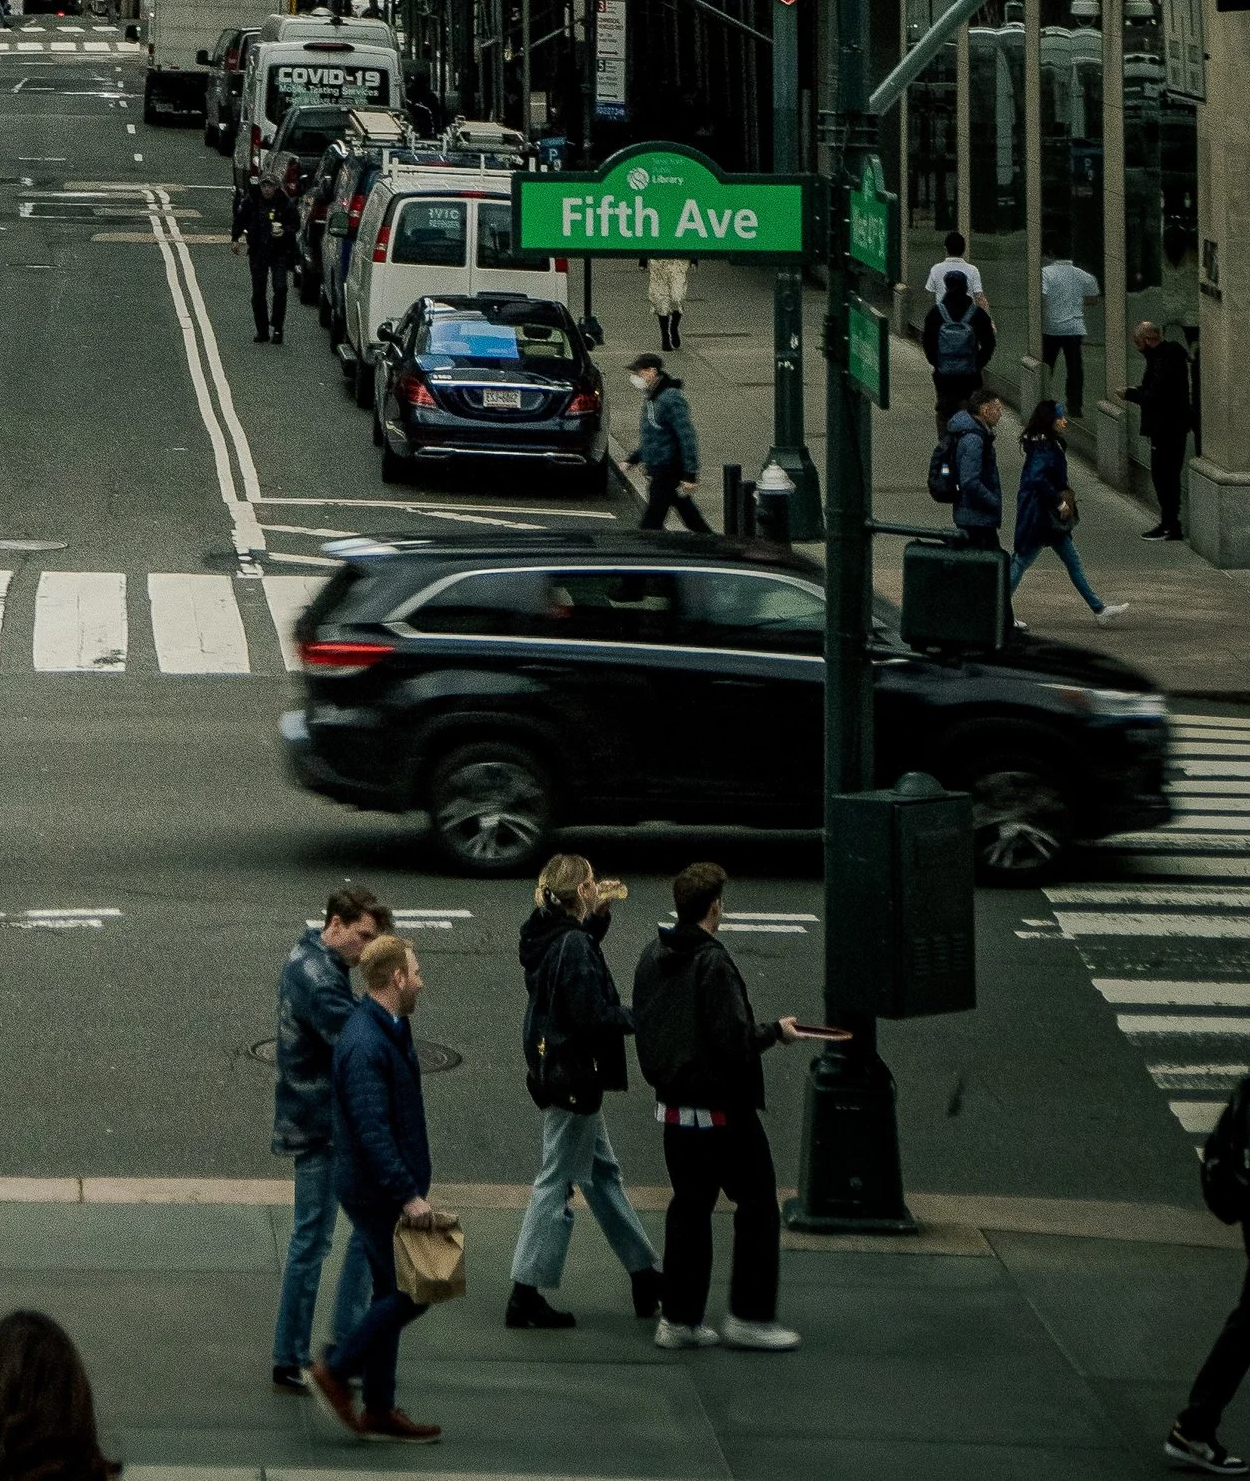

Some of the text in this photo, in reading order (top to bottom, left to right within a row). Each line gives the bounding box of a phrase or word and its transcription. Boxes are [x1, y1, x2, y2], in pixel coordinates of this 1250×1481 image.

[278, 67, 381, 87] COVID-19
[308, 85, 340, 97] Testing
[342, 86, 379, 97] Services
[651, 174, 684, 186] Library
[562, 195, 759, 239] Fifth Ave
